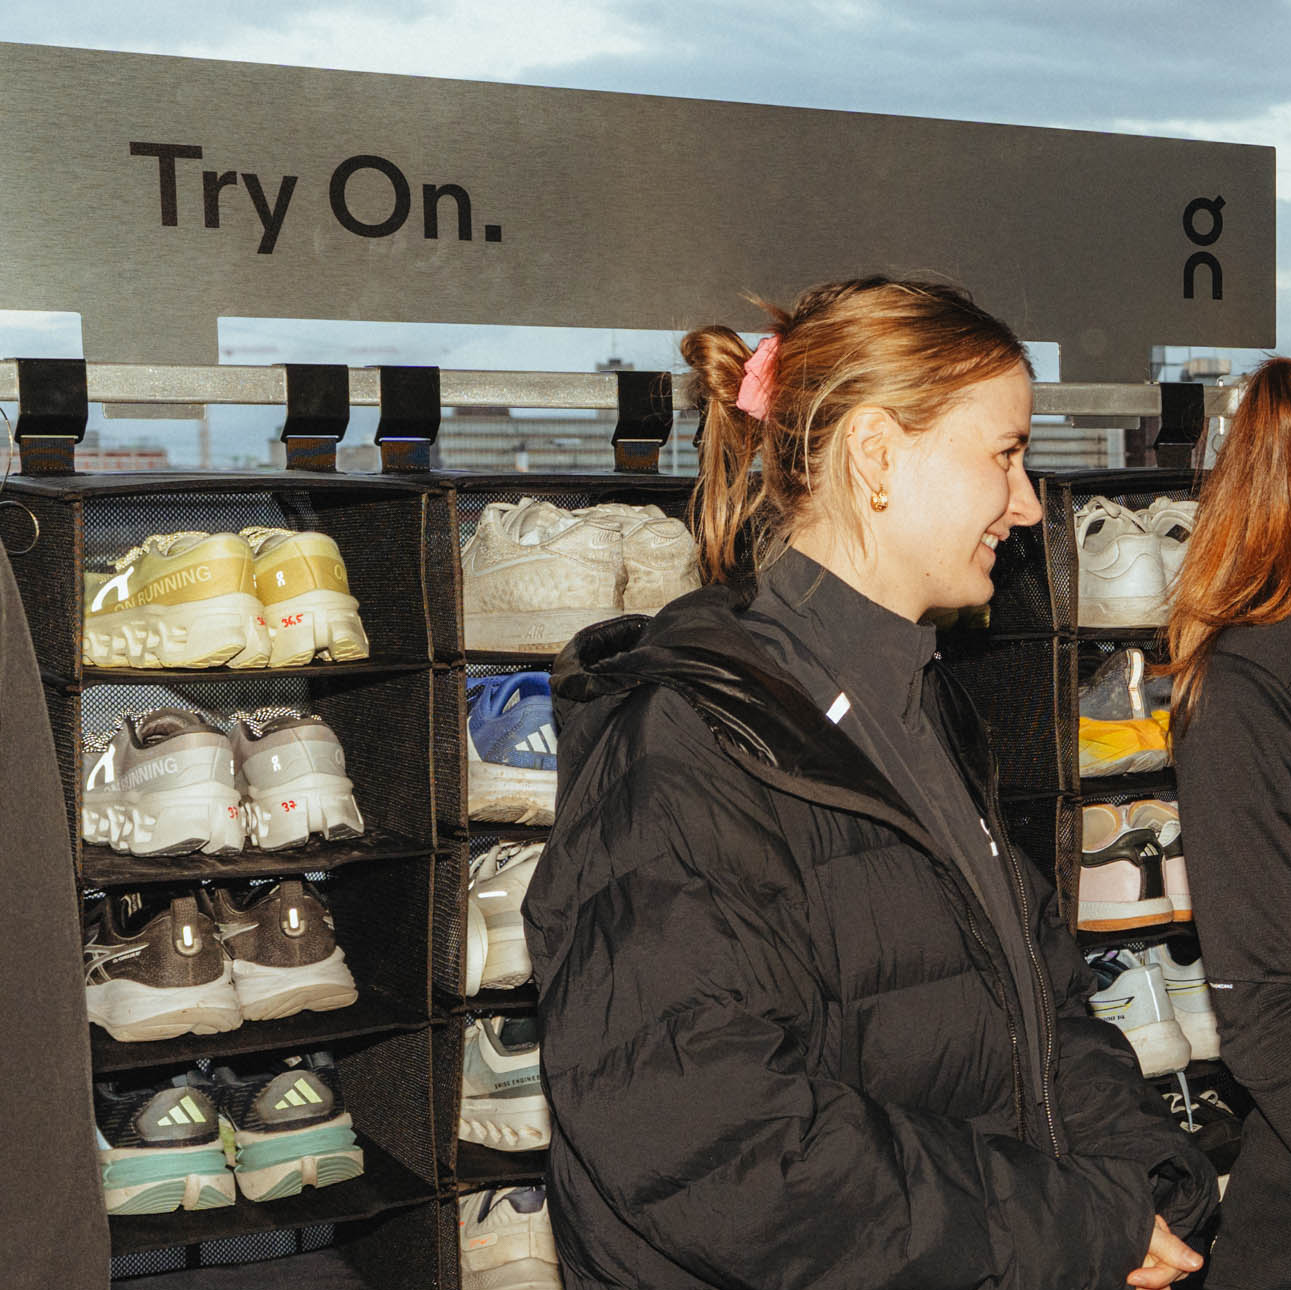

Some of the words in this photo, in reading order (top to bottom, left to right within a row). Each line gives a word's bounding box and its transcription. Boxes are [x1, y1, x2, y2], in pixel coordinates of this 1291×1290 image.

[129, 141, 298, 255] Try
[329, 154, 502, 243] On.
[138, 565, 212, 605] RUNNING
[121, 757, 178, 791] RUNNING
